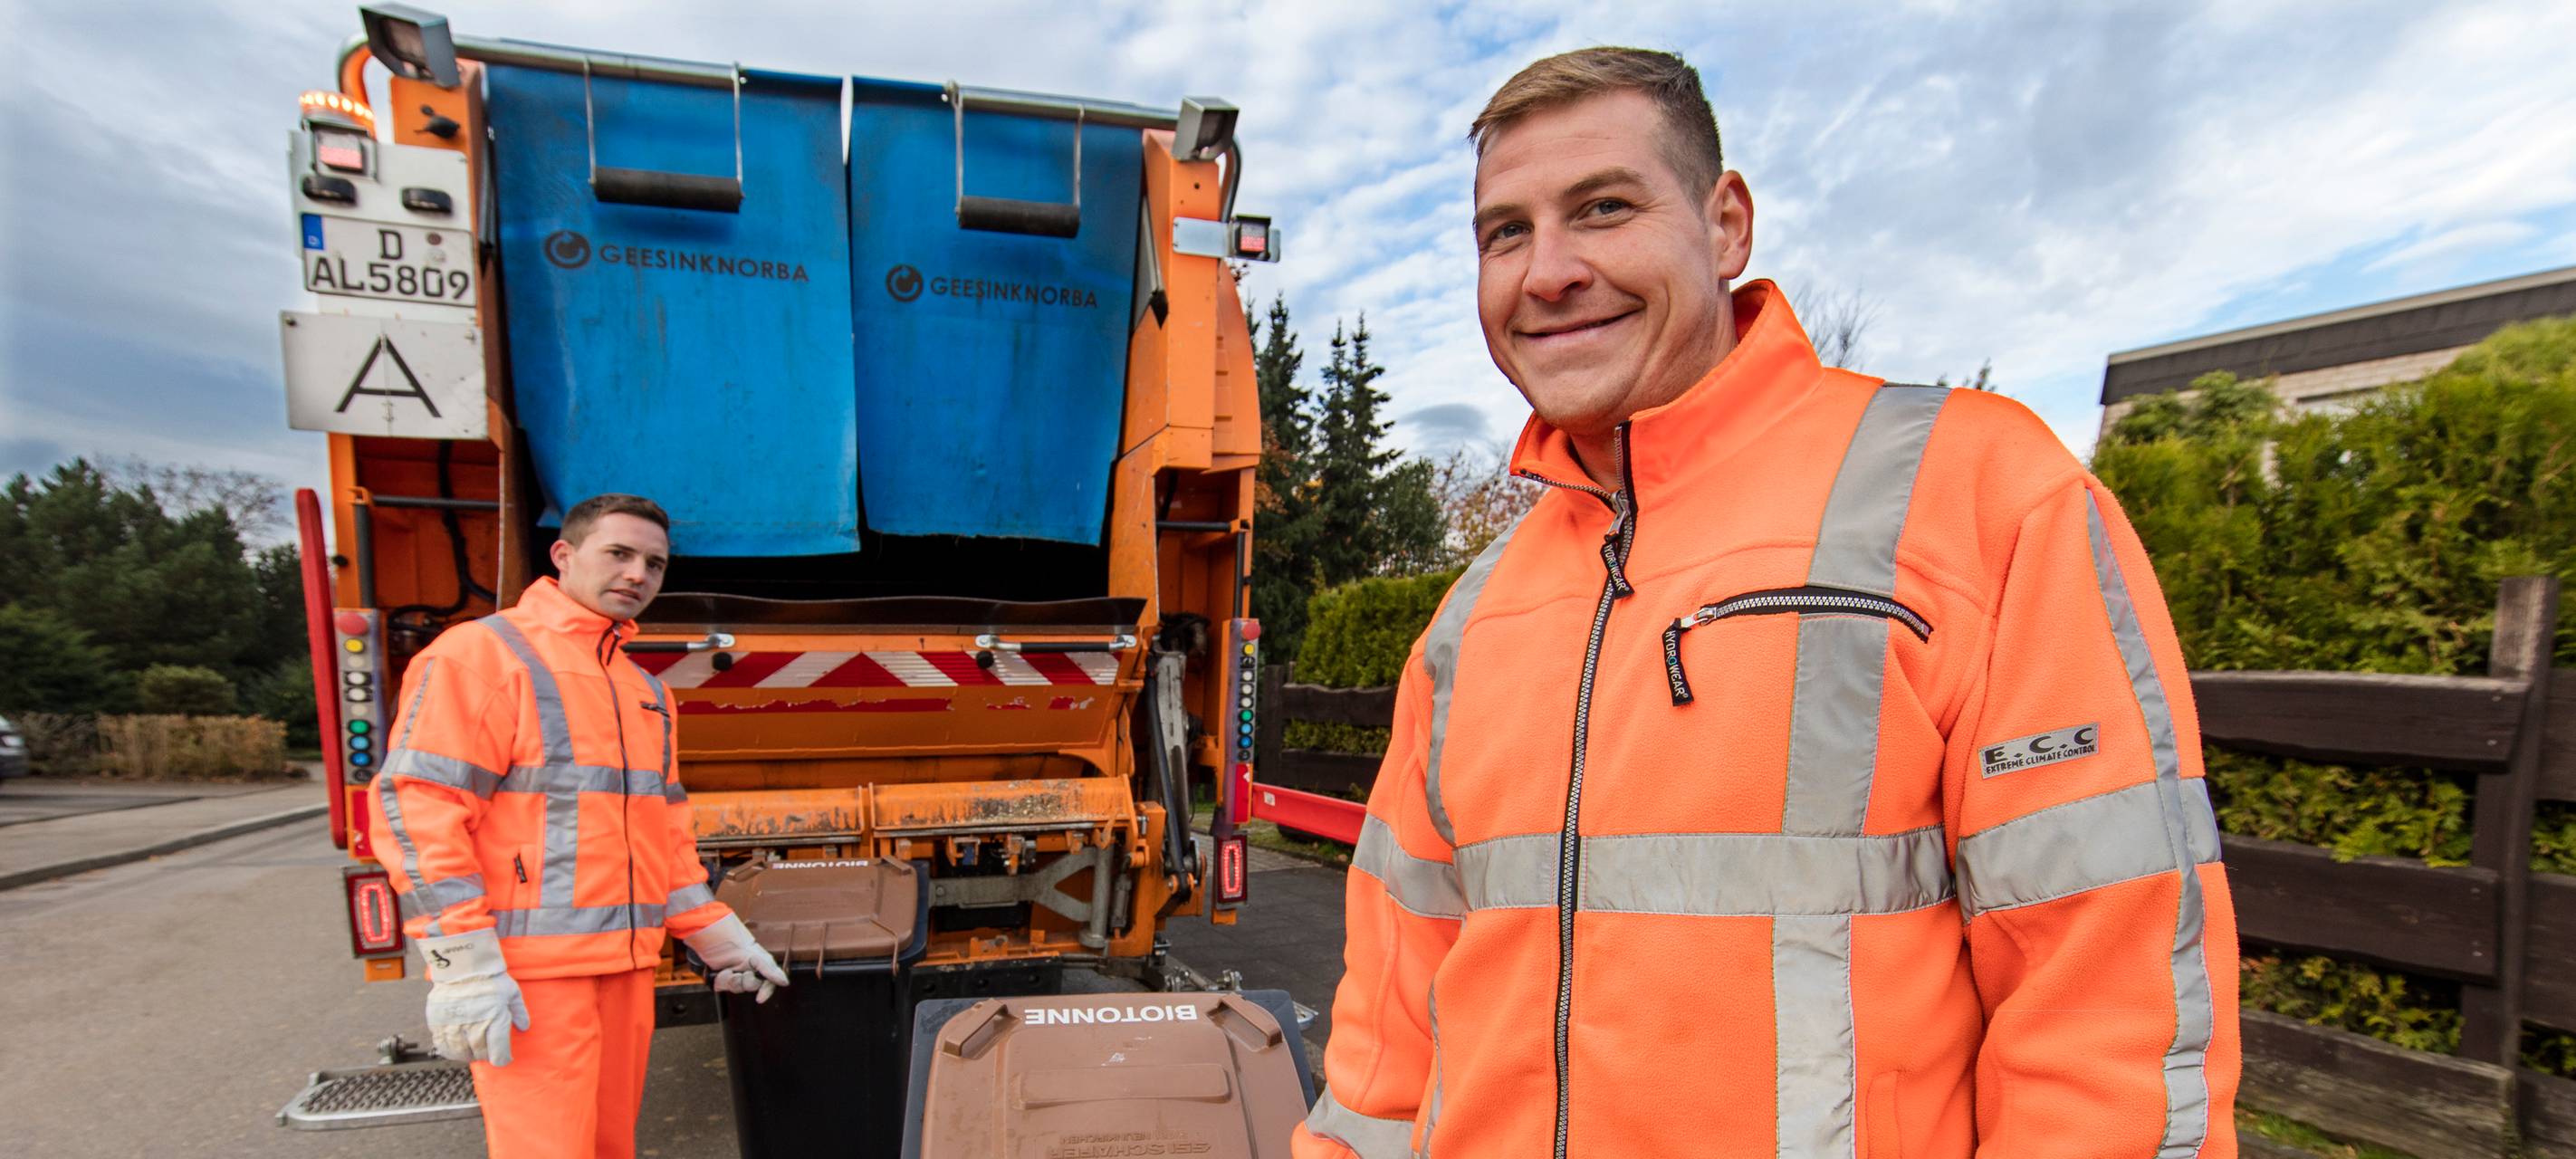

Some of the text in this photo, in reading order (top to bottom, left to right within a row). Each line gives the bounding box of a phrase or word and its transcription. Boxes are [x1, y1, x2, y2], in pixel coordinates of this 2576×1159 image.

[378, 228, 403, 261] D
[599, 244, 809, 283] GEESINKNORBA
[930, 276, 1098, 308] GEESINKNORBA
[334, 335, 442, 418] A
[1986, 744, 2095, 775] EXTREME CLIMATE CONTROL
[1024, 1004, 1198, 1025] BIOTONNE
